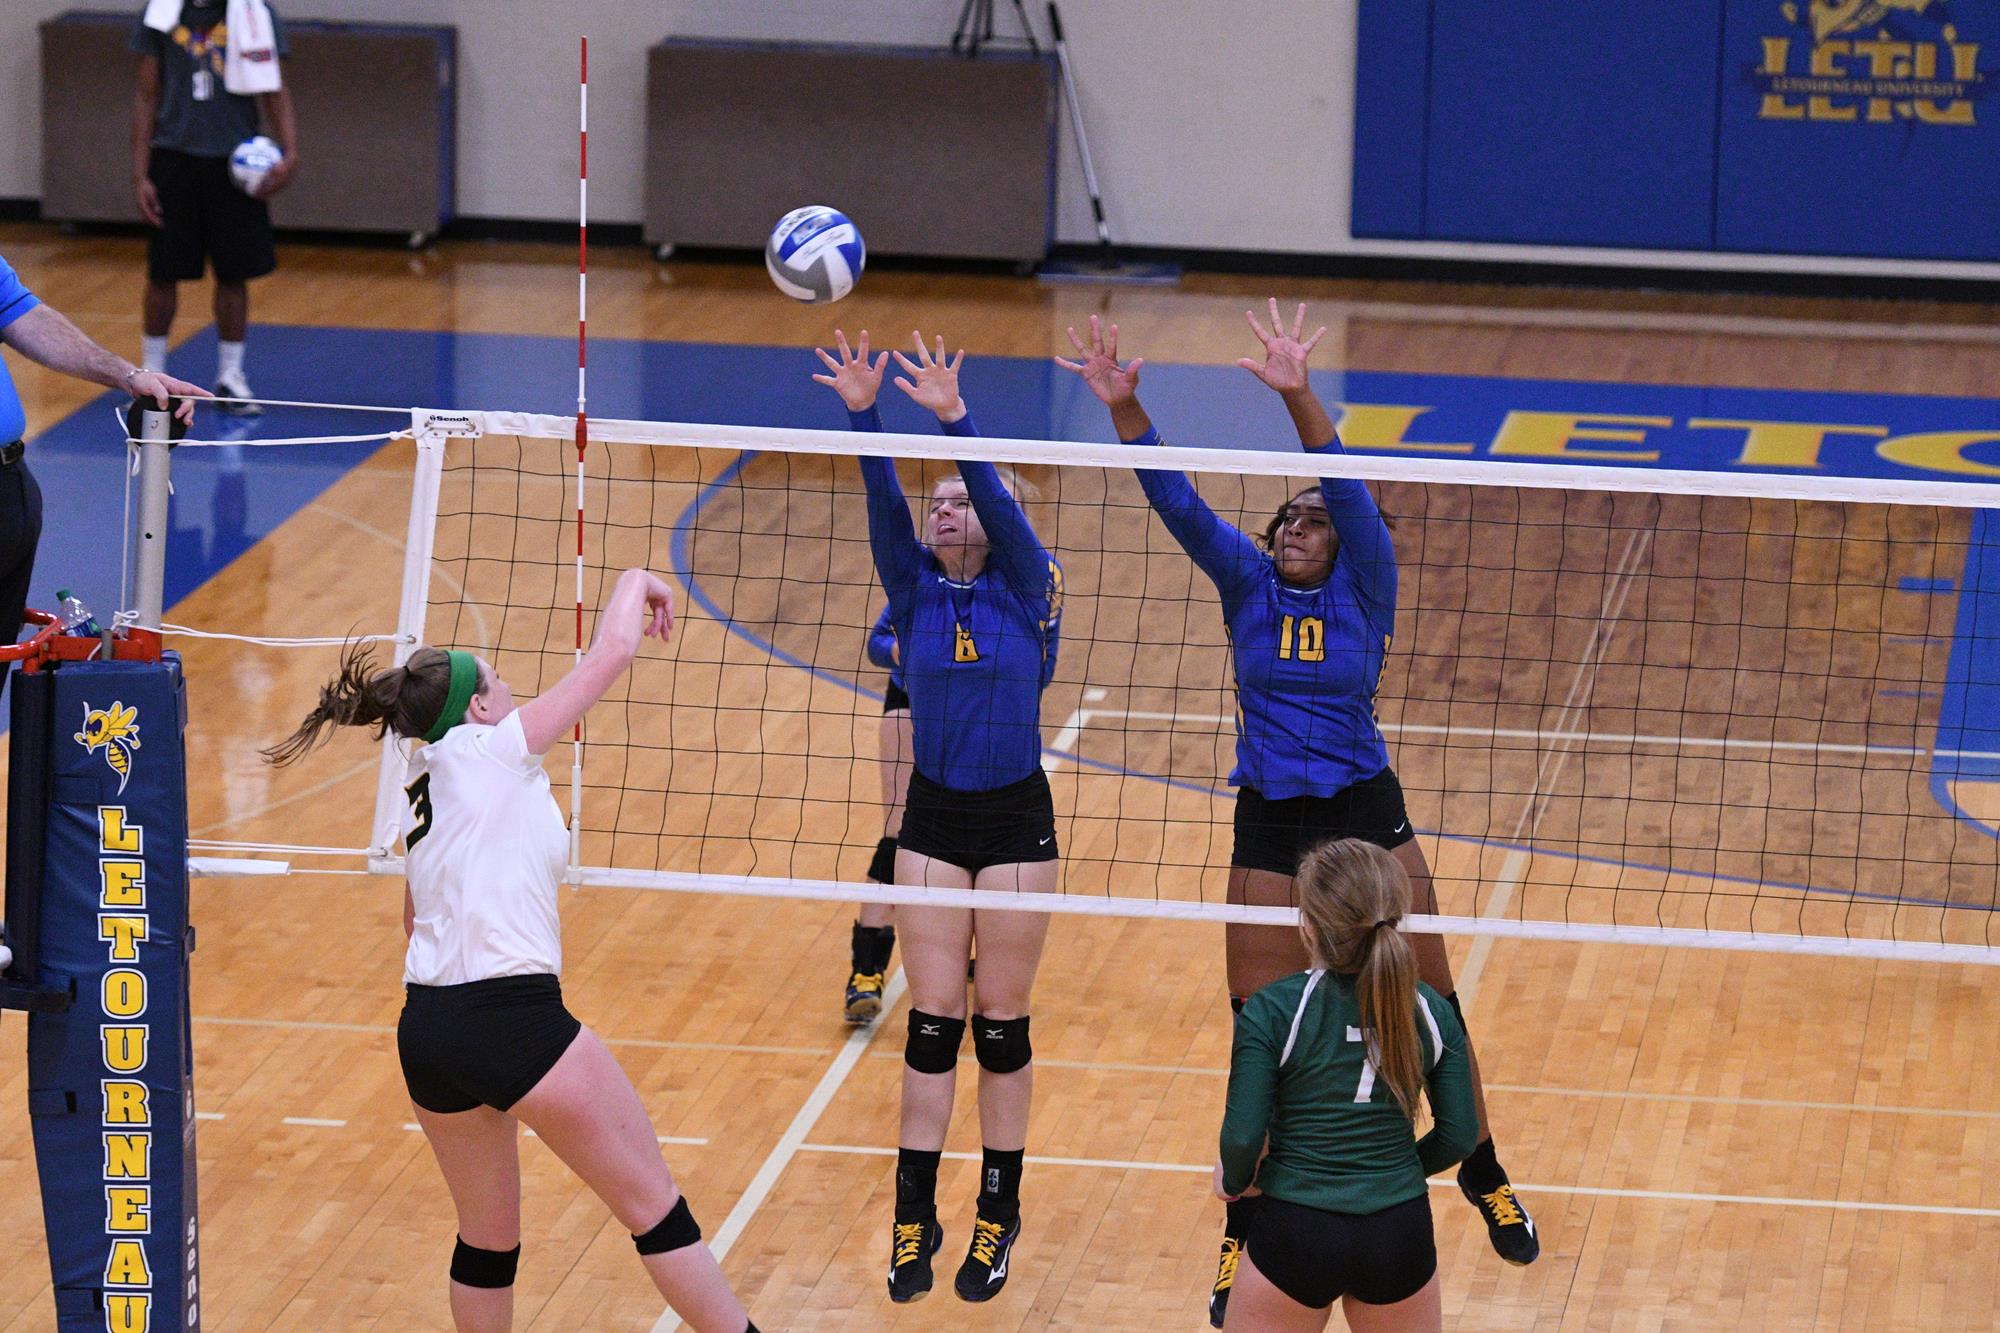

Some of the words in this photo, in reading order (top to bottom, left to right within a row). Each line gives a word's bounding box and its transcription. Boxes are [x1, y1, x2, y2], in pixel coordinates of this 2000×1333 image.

[1758, 37, 1979, 126] LETU
[1278, 614, 1325, 661] 10
[404, 771, 433, 855] 3
[97, 805, 152, 1333] LETOURNEAU
[1346, 1025, 1382, 1104] 7
